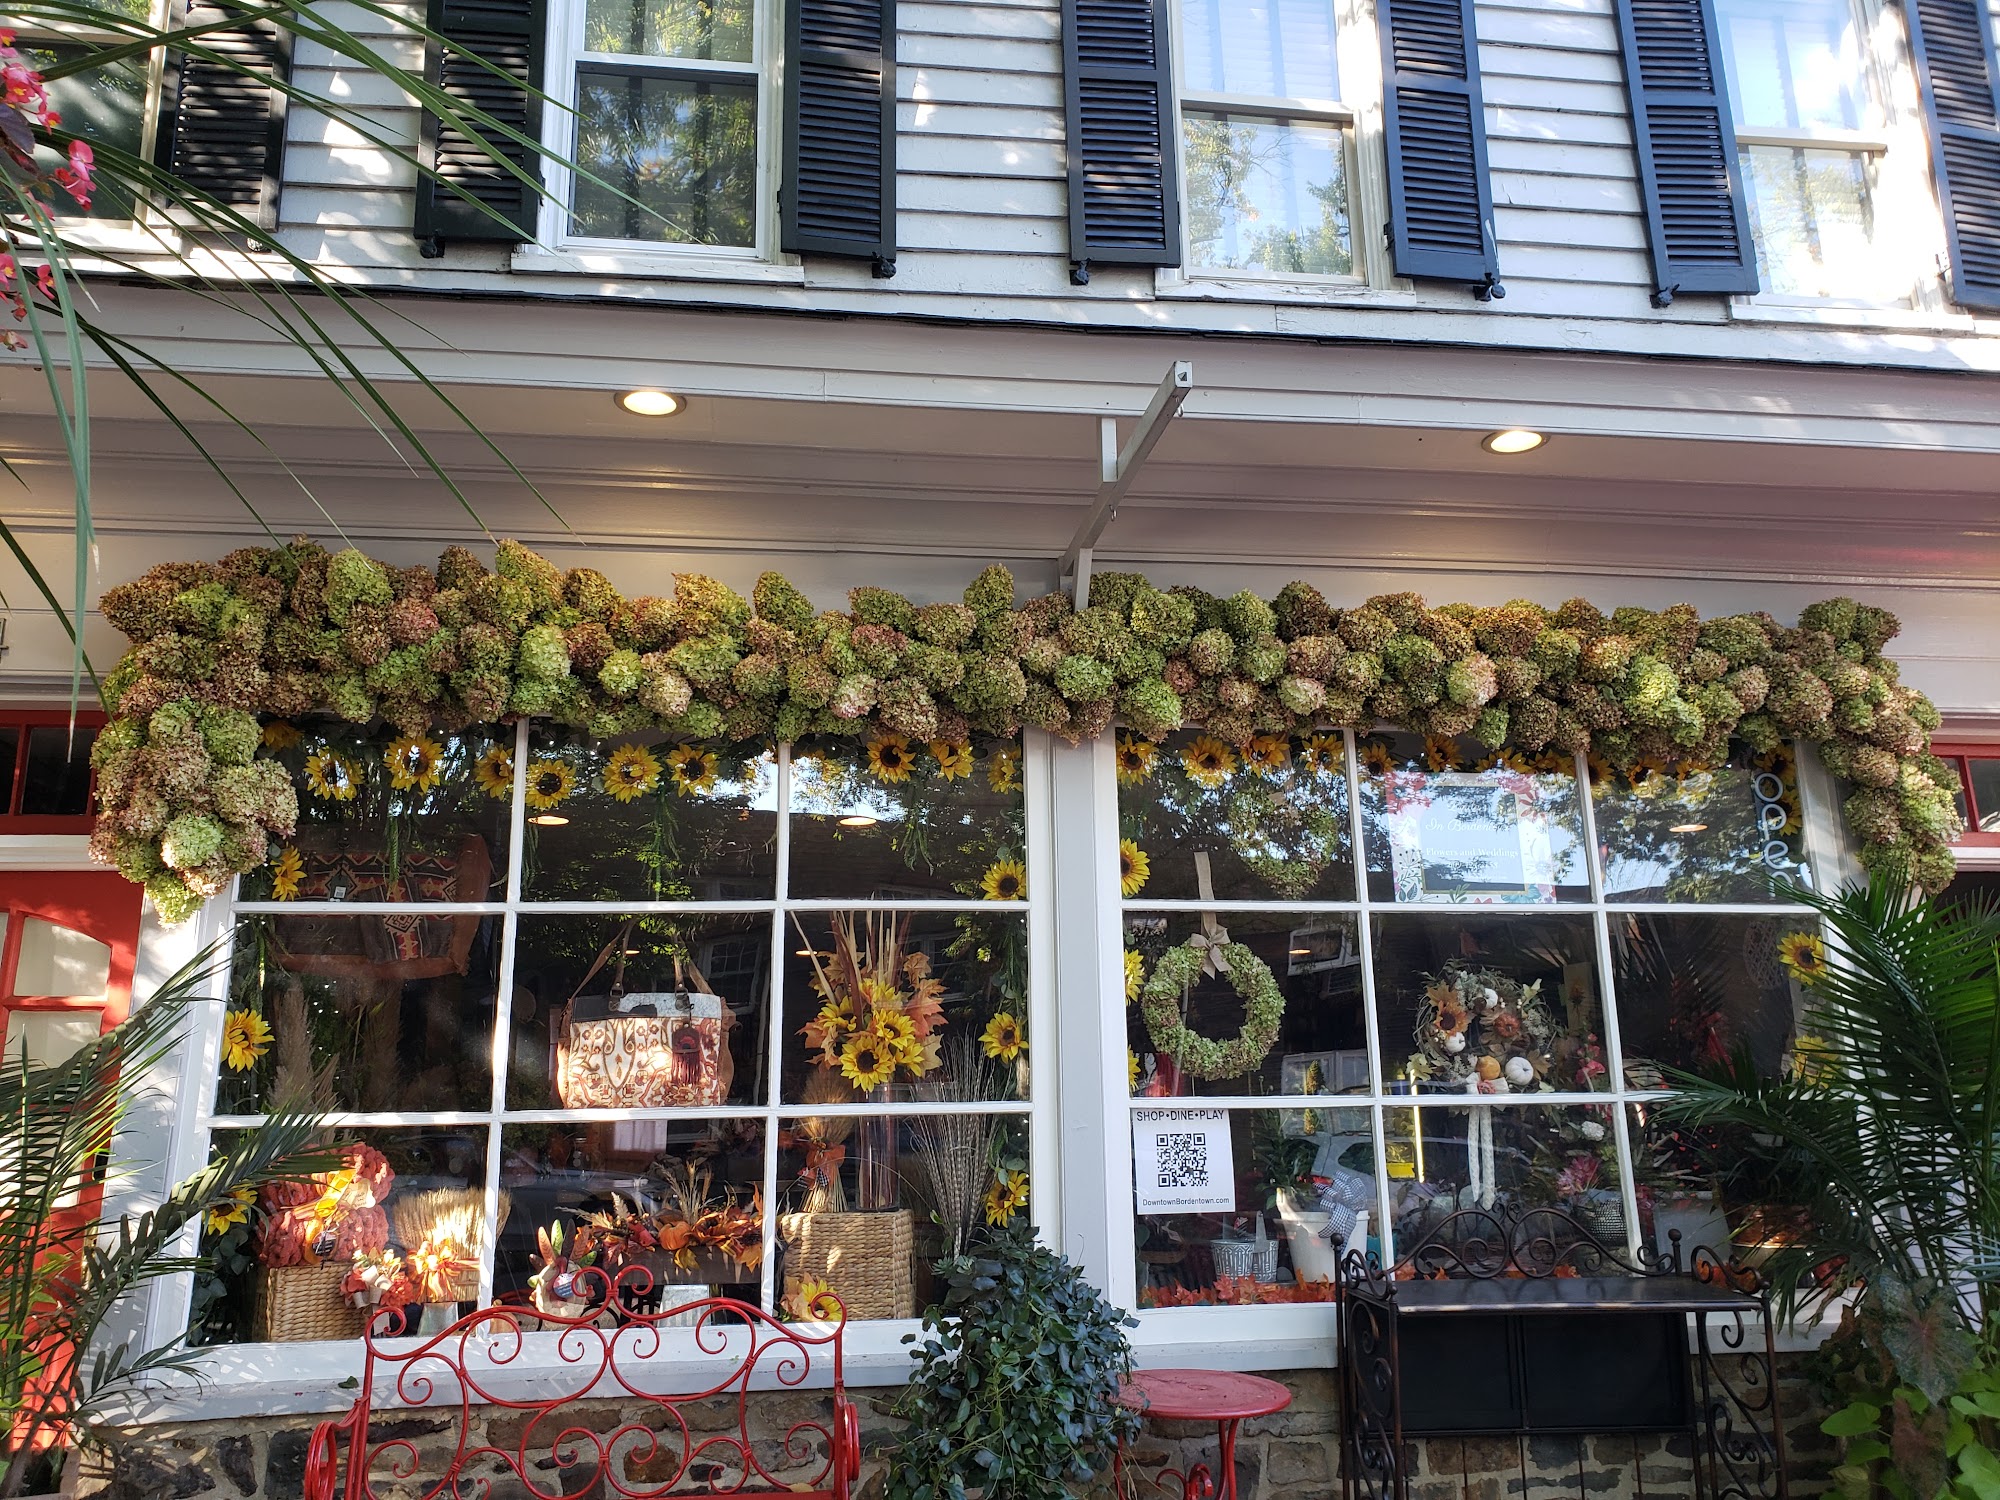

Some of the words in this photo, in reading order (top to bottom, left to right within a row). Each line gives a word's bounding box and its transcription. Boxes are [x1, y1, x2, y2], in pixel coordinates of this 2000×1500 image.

[1426, 818, 1444, 831] In
[1448, 819, 1510, 831] Bordent
[1426, 847, 1459, 856] Flowers
[1460, 847, 1475, 856] and
[1477, 848, 1518, 857] Weddings
[1143, 1198, 1229, 1206] DowntownBordentown.com
